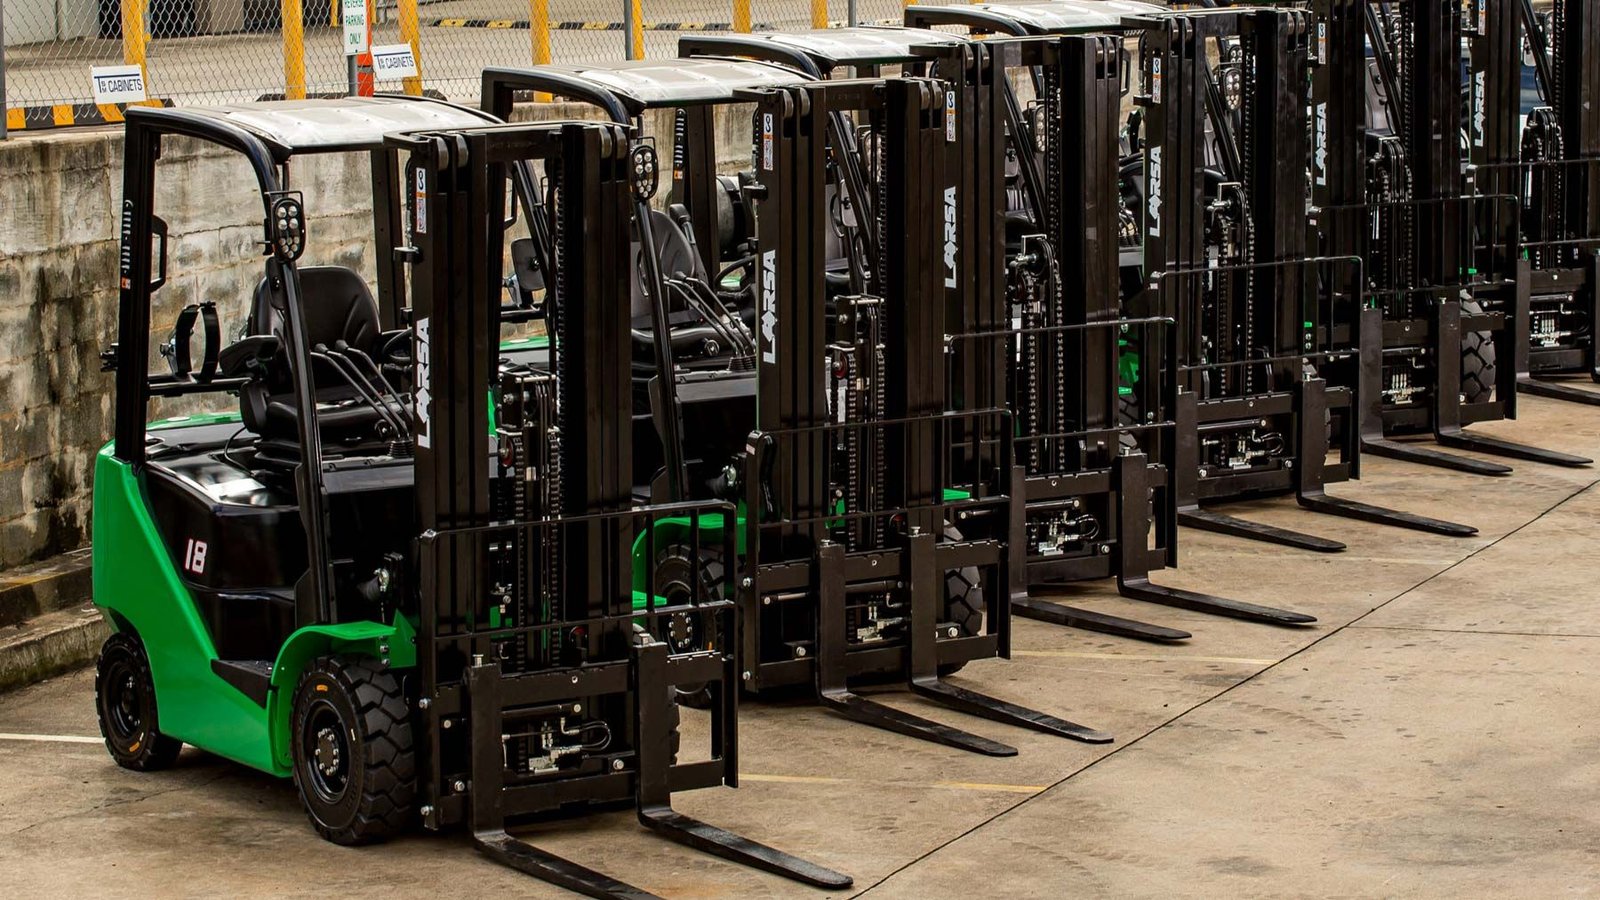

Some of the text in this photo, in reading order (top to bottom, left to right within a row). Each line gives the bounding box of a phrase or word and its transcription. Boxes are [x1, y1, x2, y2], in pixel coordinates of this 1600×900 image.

[345, 14, 365, 26] PARKING
[349, 32, 361, 45] ONLY
[107, 78, 143, 93] CABINETS
[385, 55, 415, 69] CABINETS
[1315, 102, 1328, 186] LARSA
[1473, 70, 1486, 147] LARSA
[1148, 145, 1163, 238] LARSA
[943, 185, 959, 289] LARSA
[761, 249, 778, 364] LARSA
[415, 317, 433, 449] LARSA
[184, 538, 208, 574] 18
